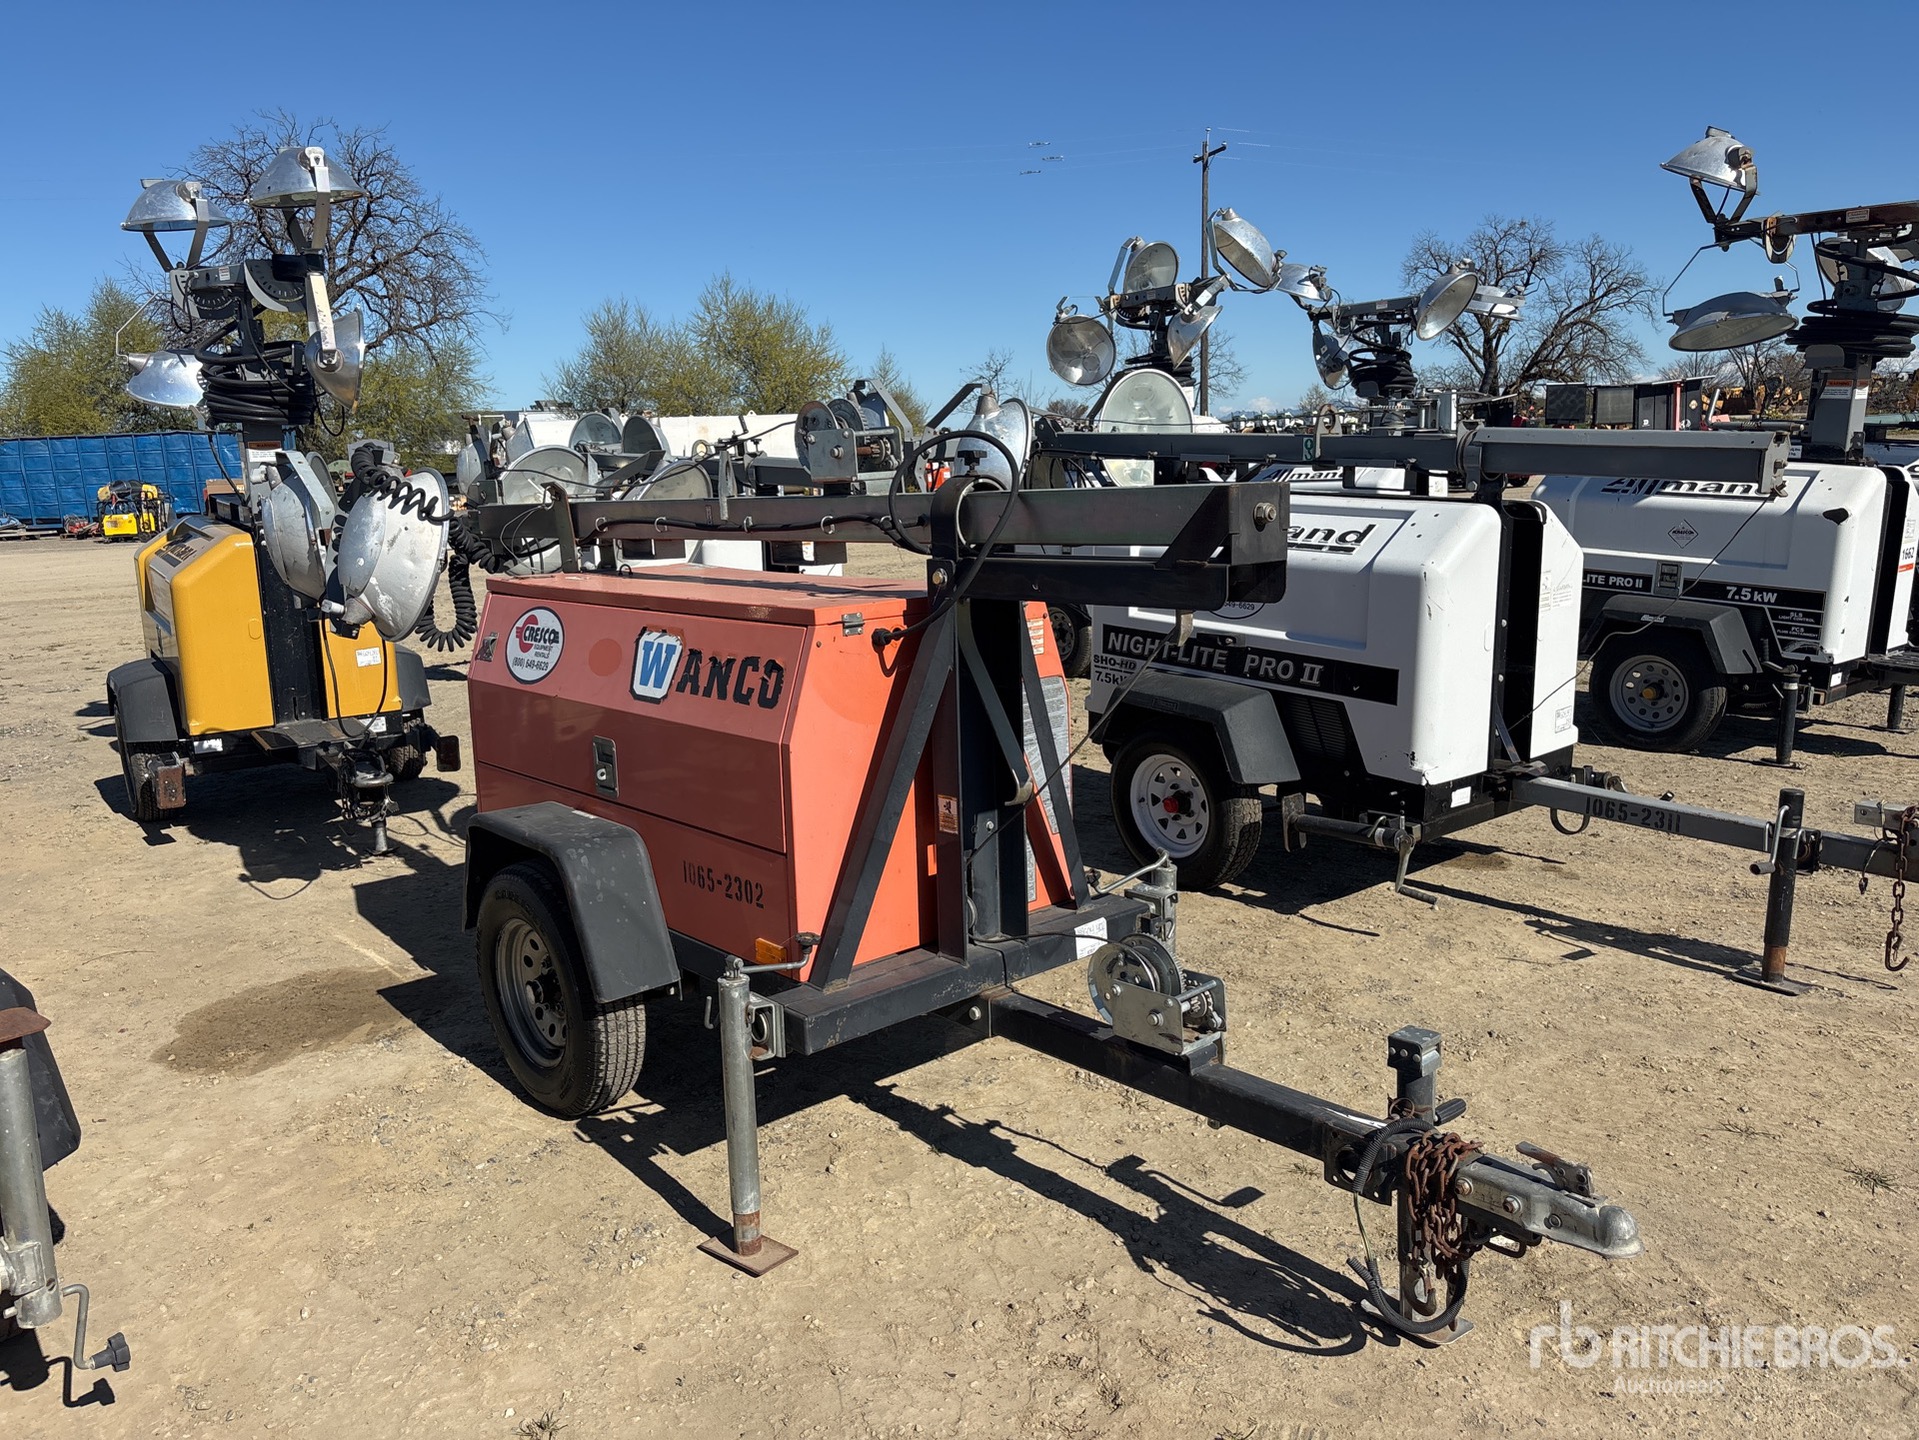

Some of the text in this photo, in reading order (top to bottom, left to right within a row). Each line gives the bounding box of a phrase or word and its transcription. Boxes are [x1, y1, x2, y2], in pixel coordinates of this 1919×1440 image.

[1608, 576, 1634, 588] PRO
[1635, 578, 1643, 588] II
[524, 626, 556, 645] CRESCO
[630, 627, 785, 709] WANCO
[1093, 653, 1138, 671] SHO-HD
[1243, 653, 1295, 681] PRO
[1300, 661, 1325, 685] II
[1585, 796, 1681, 833] 1065-2311
[683, 860, 764, 909] 1065-2302
